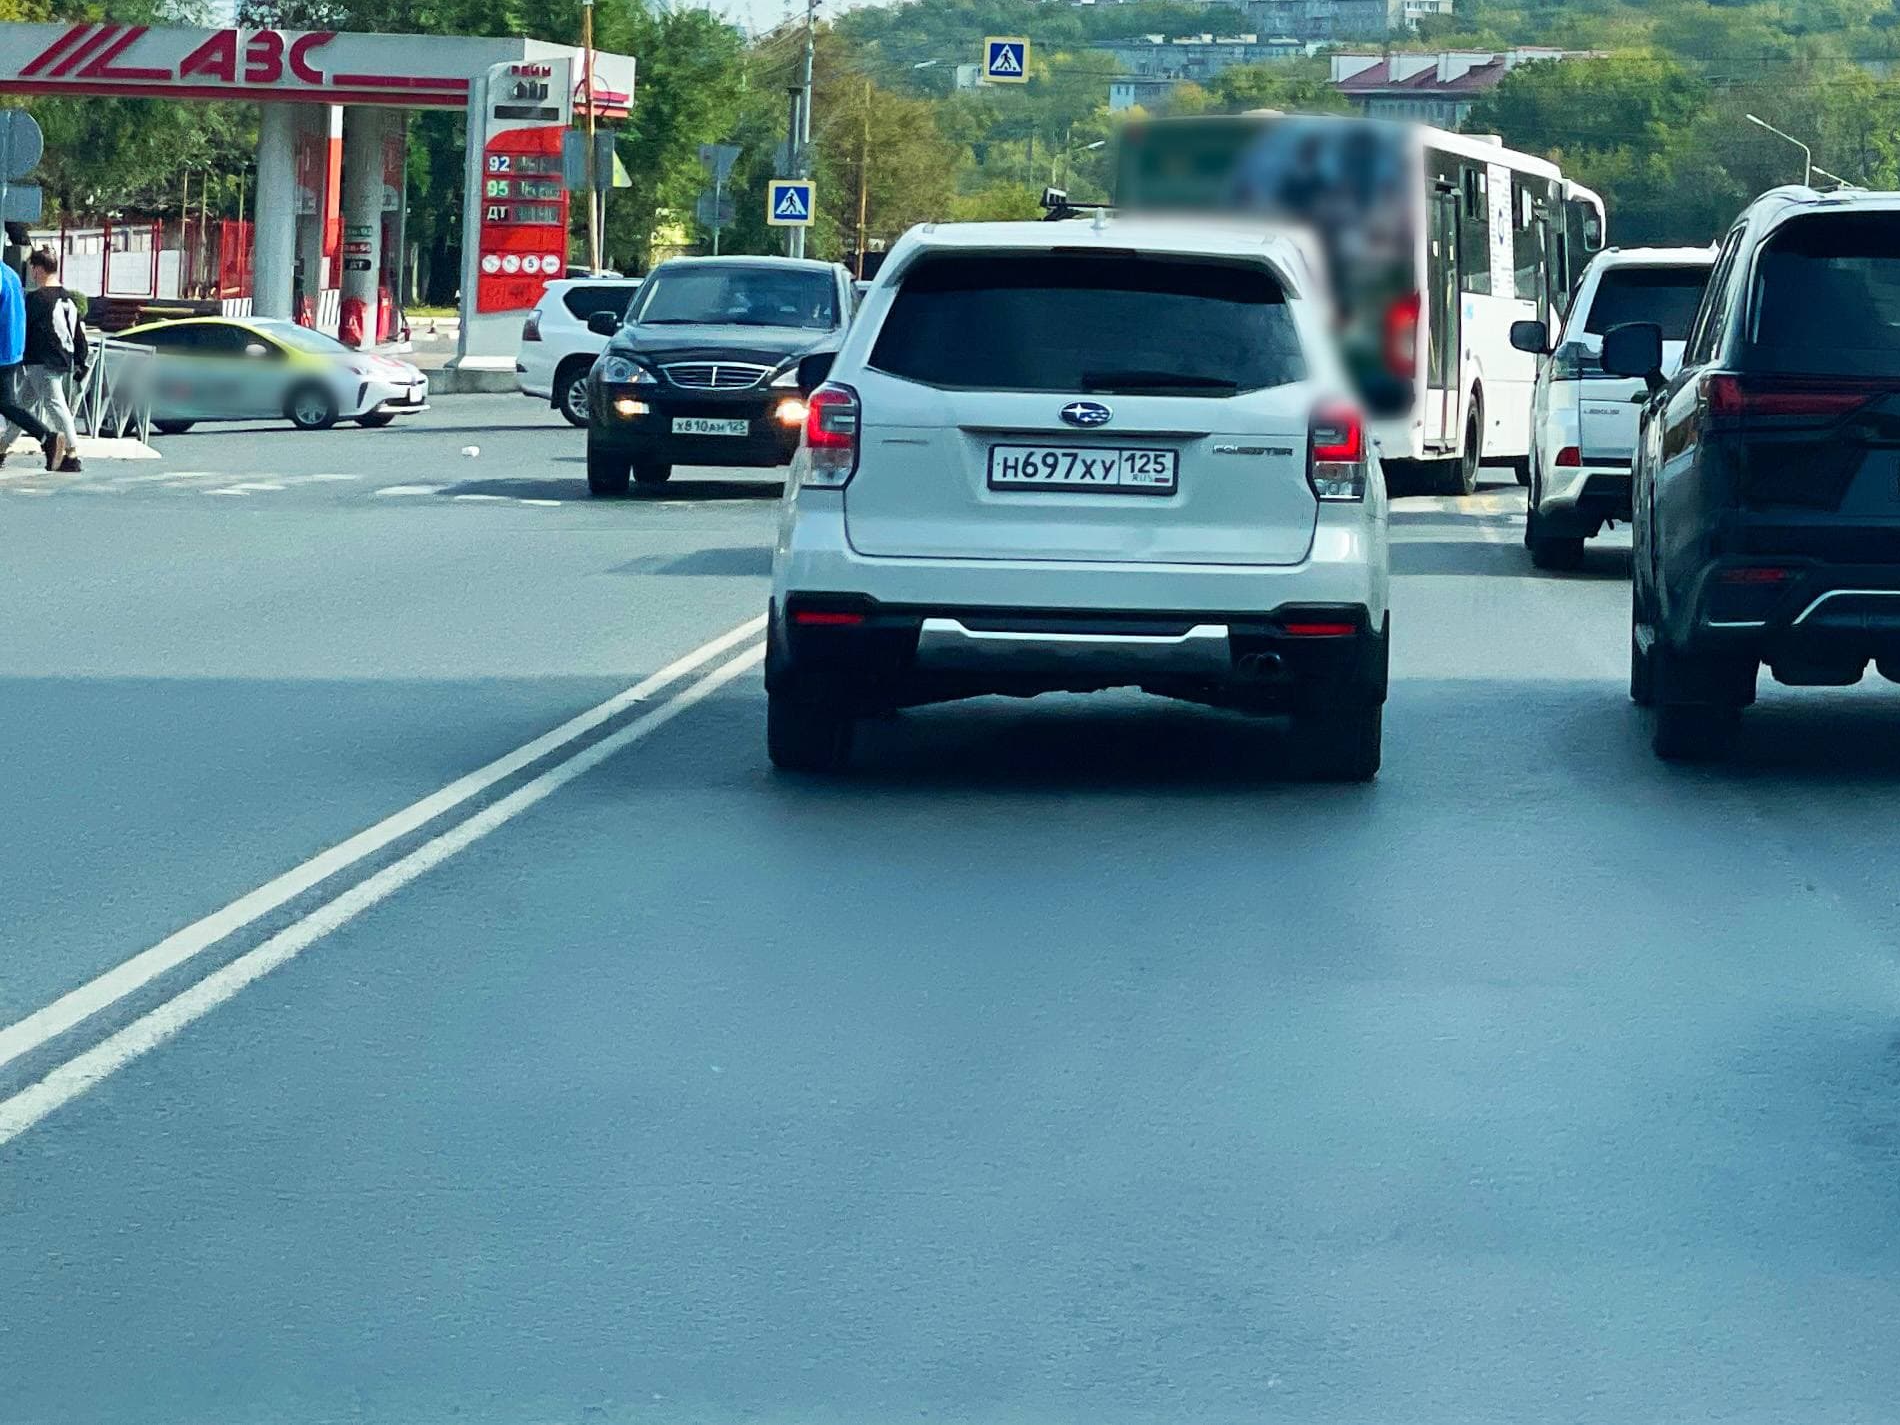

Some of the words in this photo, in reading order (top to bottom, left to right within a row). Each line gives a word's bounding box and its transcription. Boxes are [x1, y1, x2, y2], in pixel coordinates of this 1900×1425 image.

[180, 29, 336, 84] АЗС
[489, 156, 510, 172] 92
[486, 180, 509, 197] 95
[487, 206, 509, 221] ДТ
[1124, 453, 1167, 474] 125
